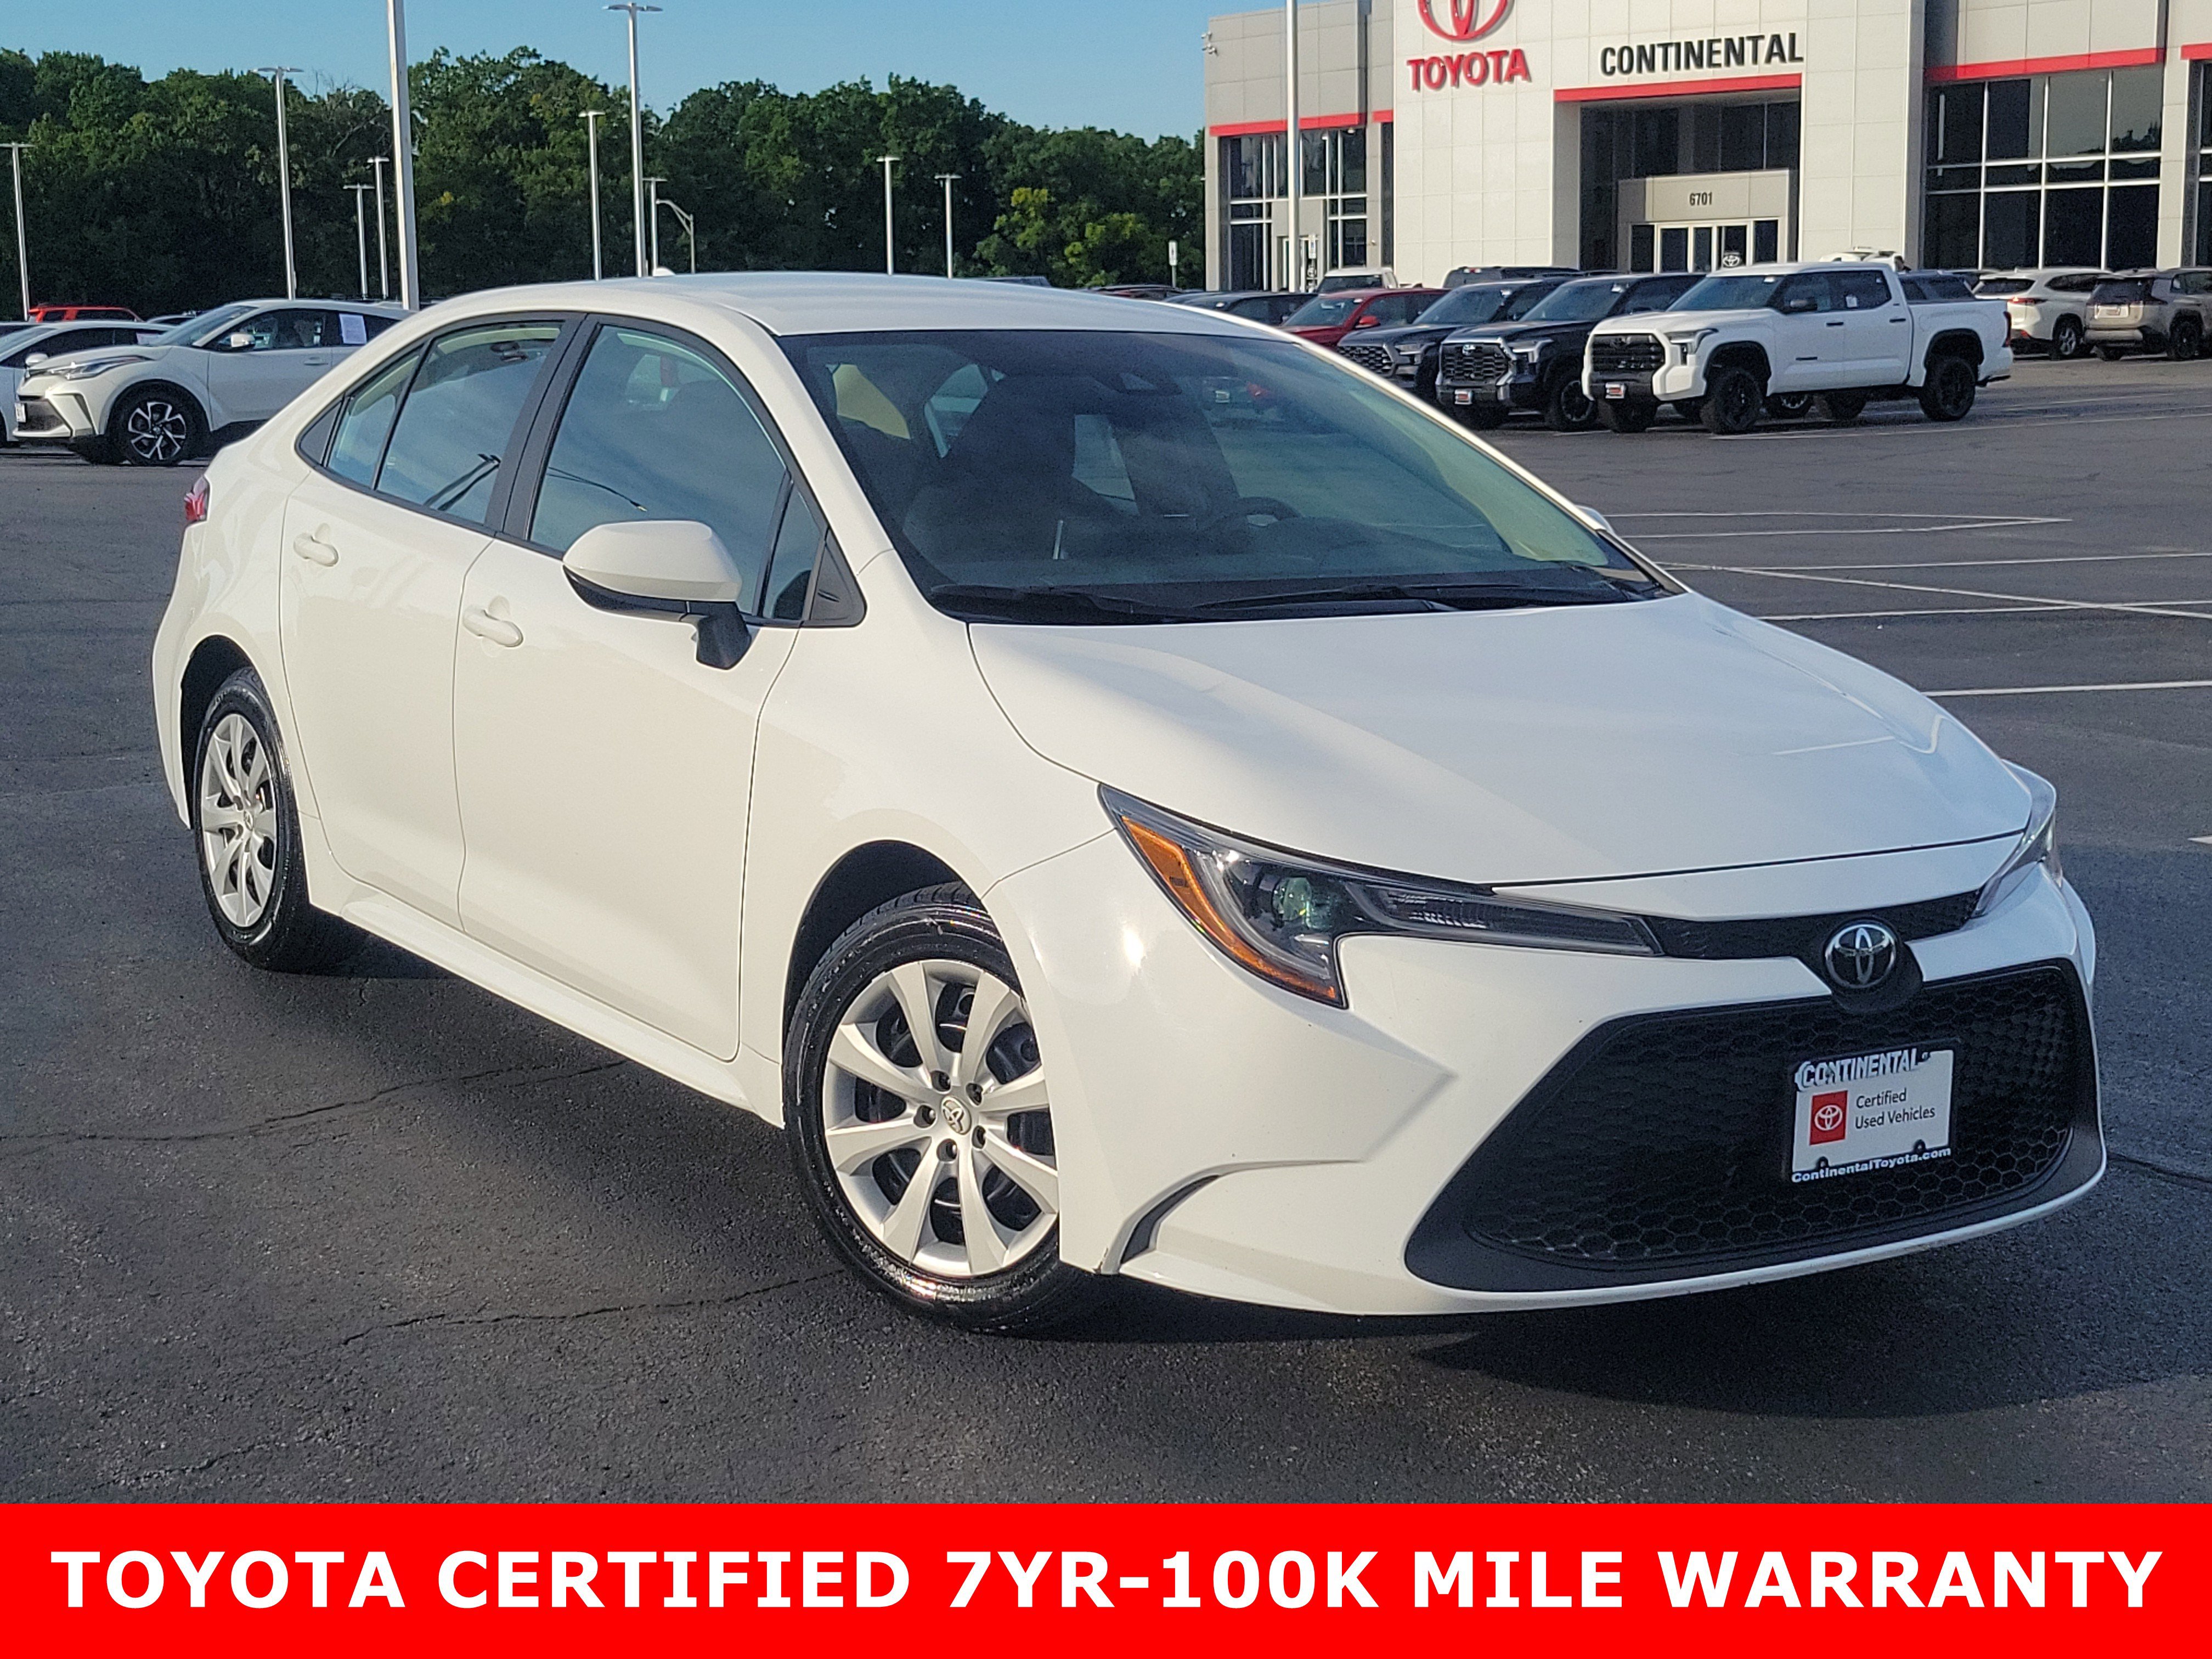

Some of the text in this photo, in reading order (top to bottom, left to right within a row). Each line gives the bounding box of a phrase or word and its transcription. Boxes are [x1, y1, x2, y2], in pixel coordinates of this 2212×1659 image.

[1407, 48, 1531, 92] TOYOTA
[1600, 32, 1804, 76] CONTINENTAL
[1689, 191, 1713, 206] 6701
[1801, 1048, 1919, 1088] CONTINENTAL
[1856, 1087, 1907, 1109] Certified
[1855, 1105, 1936, 1130] Used Vehicles
[1791, 1147, 1951, 1183] ContinentalToyota.com
